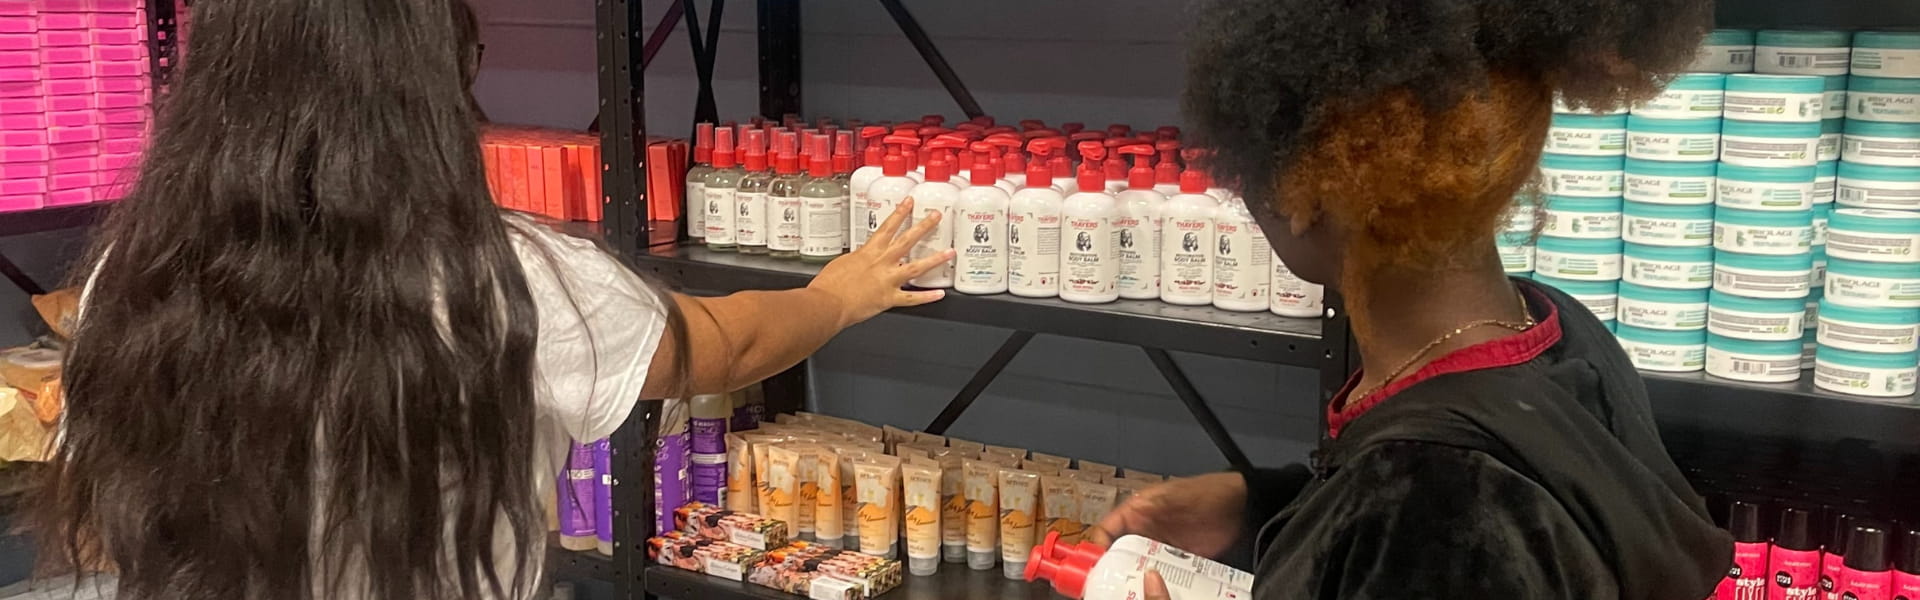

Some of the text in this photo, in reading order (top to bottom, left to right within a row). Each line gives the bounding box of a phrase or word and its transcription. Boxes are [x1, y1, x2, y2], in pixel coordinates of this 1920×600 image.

[1176, 221, 1206, 229] THAYERS
[1736, 577, 1765, 589] style
[1786, 587, 1817, 597] style
